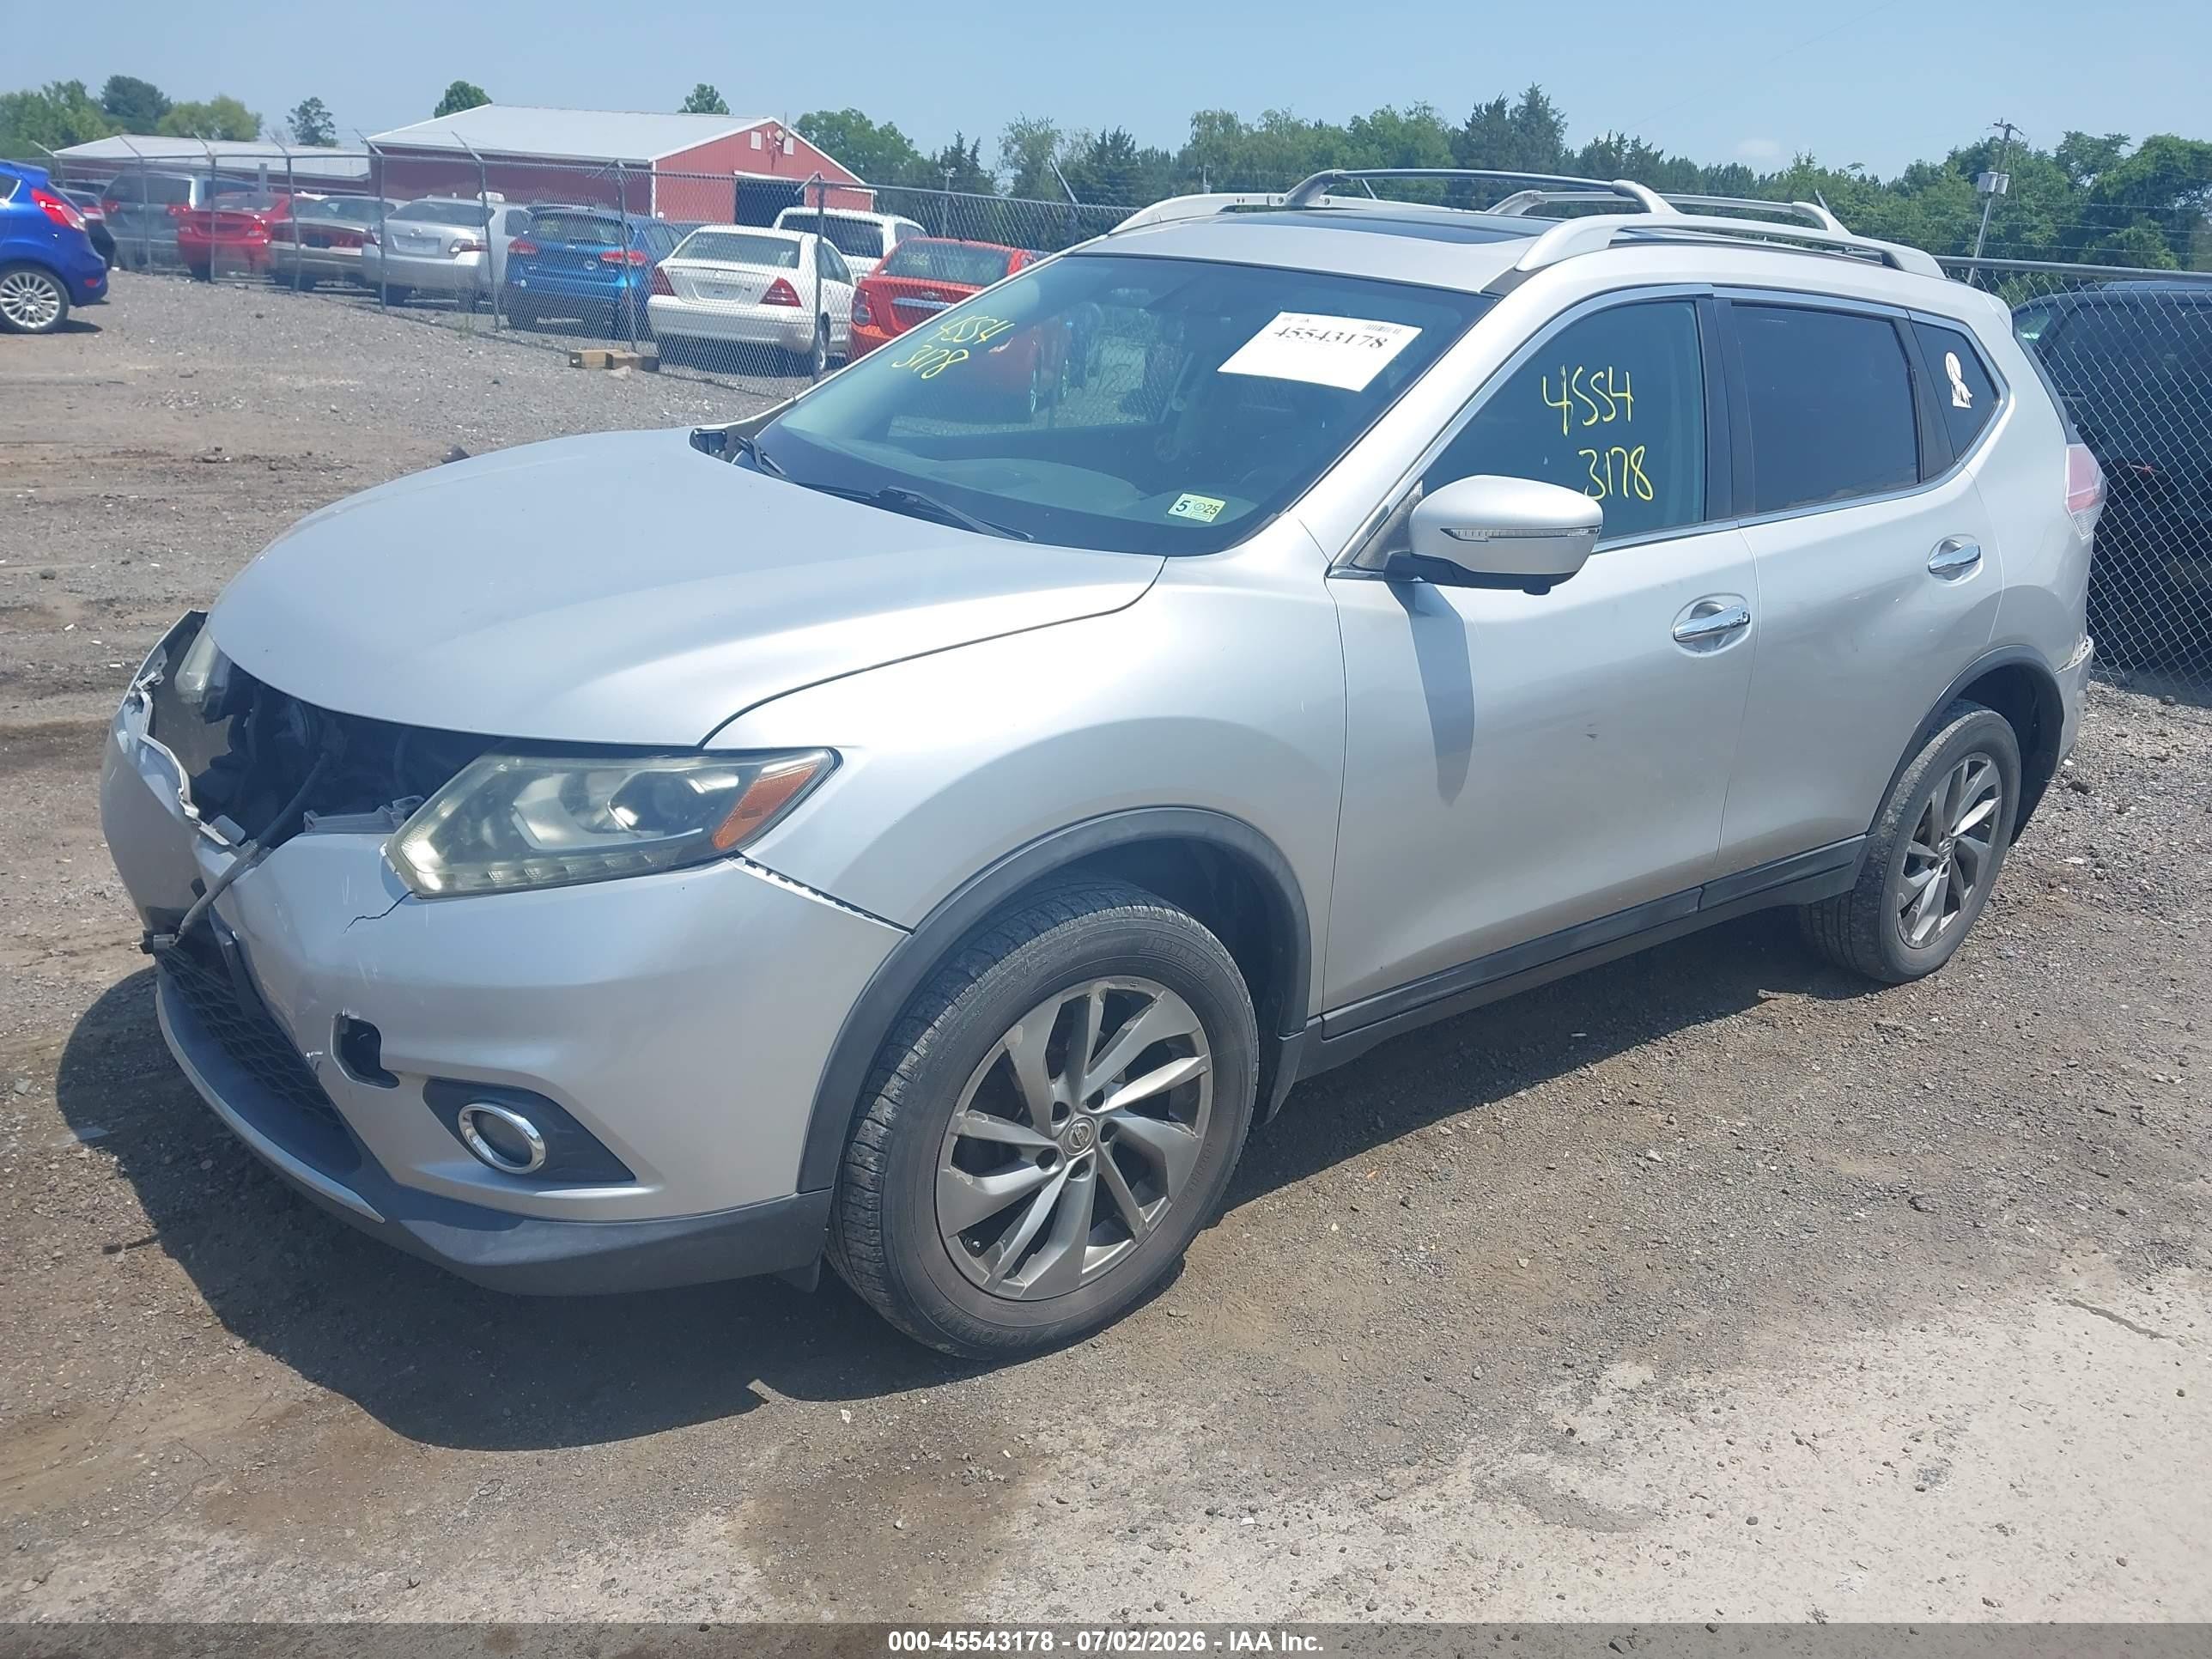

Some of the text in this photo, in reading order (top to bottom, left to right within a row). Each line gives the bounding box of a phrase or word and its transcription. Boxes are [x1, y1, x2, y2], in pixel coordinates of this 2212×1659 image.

[927, 315, 1016, 344] 4554
[1273, 326, 1389, 349] 45543178
[890, 344, 969, 380] 3178
[1542, 364, 1635, 437] 4554
[1578, 445, 1655, 501] 3178
[1176, 500, 1191, 513] 5
[1203, 504, 1219, 515] 25
